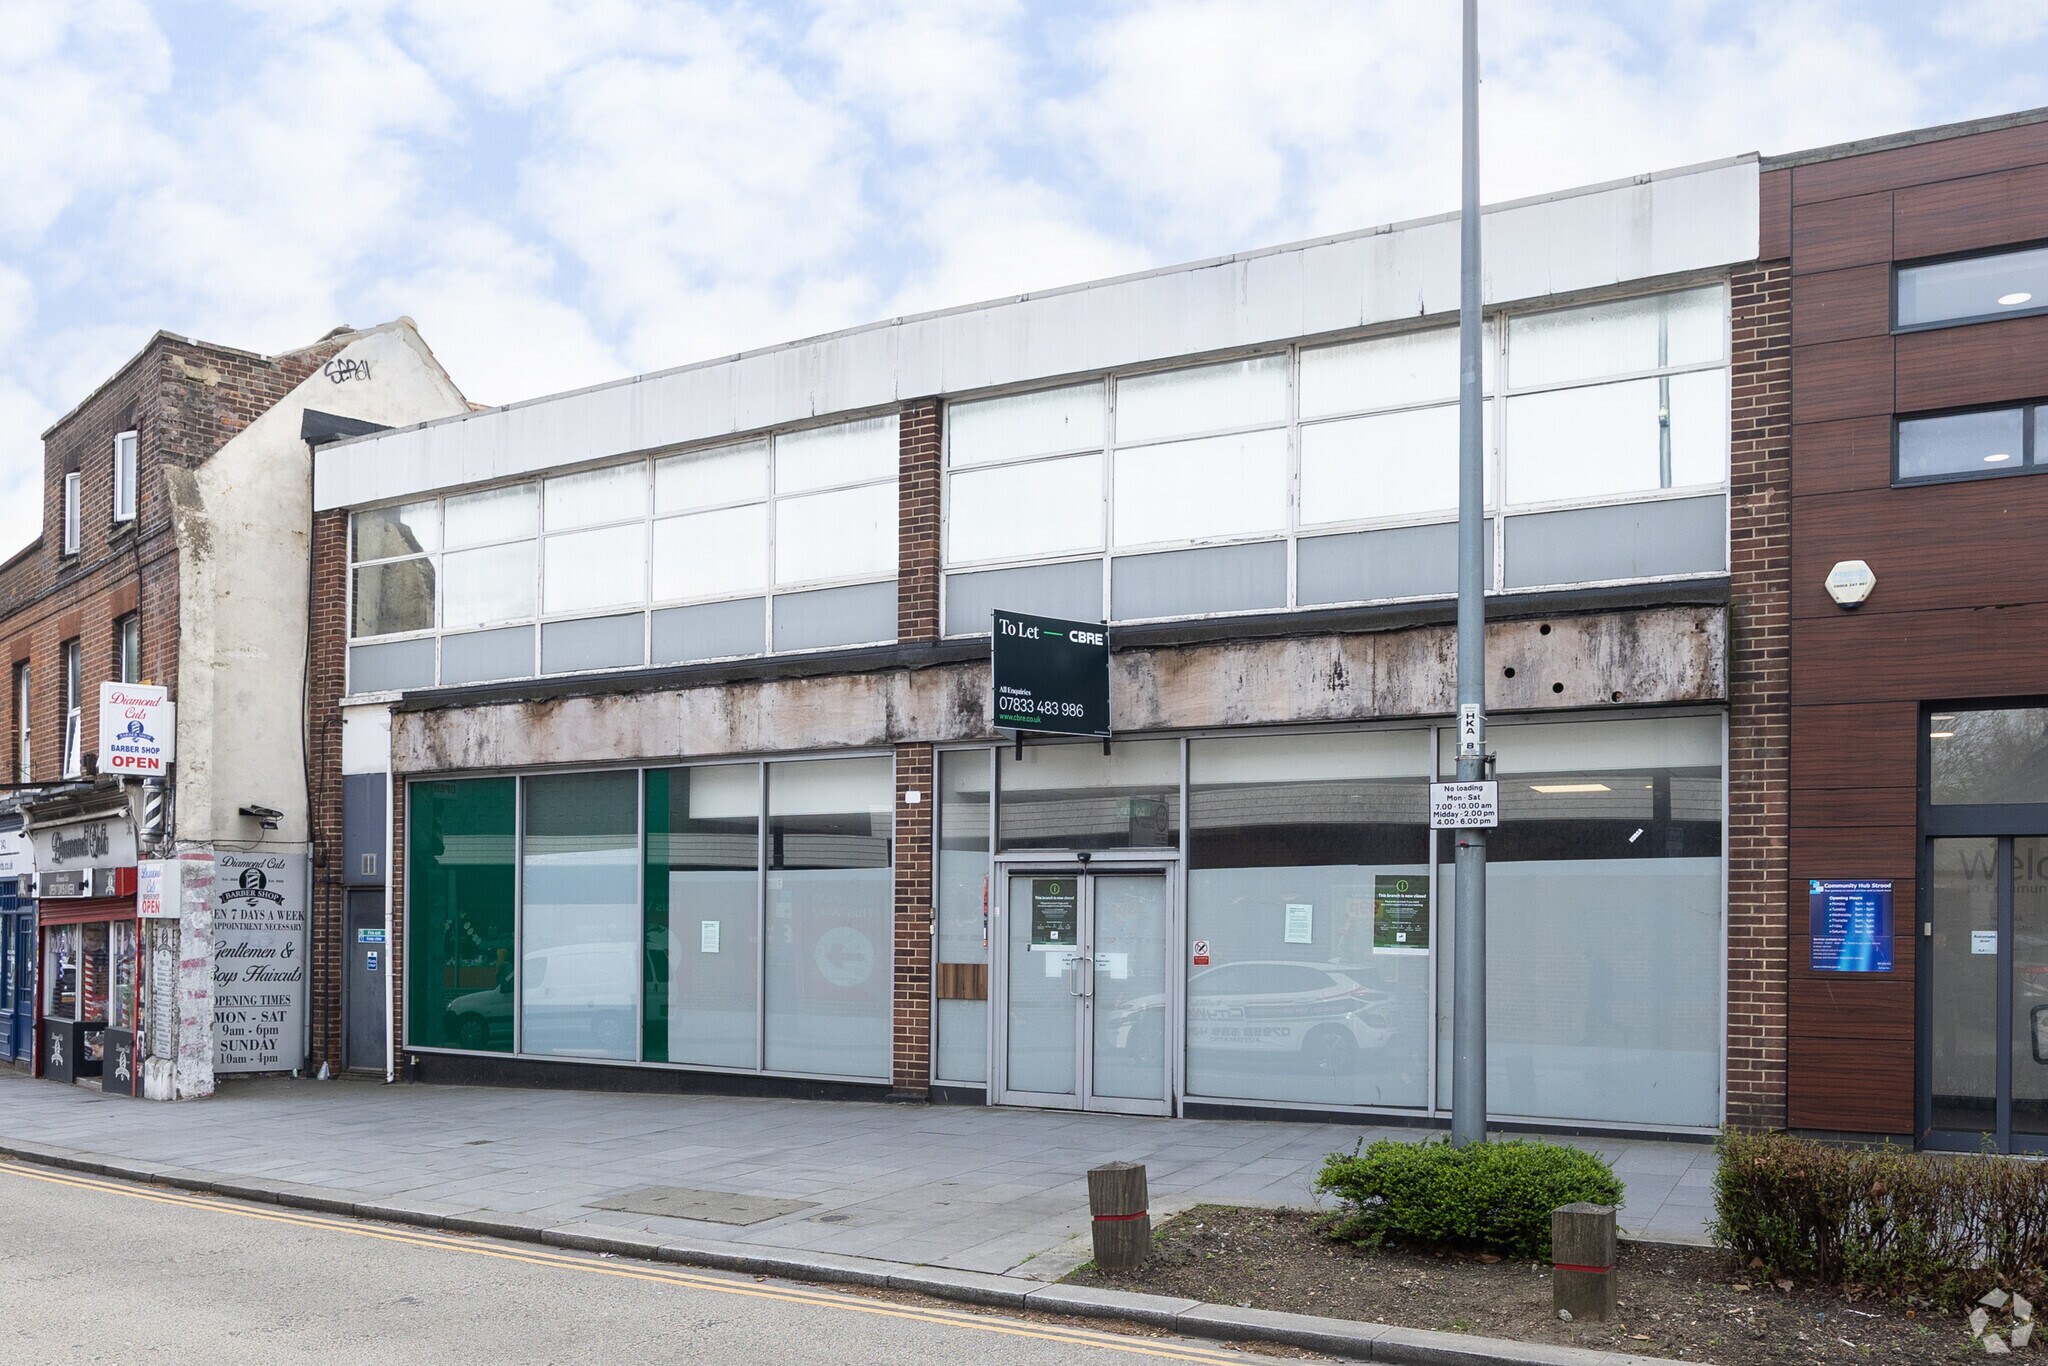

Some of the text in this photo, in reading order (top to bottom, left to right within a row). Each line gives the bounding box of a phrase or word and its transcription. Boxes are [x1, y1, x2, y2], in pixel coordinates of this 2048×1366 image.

[999, 619, 1039, 639] To Let
[1069, 630, 1103, 645] CBRE
[1008, 687, 1031, 696] Enquiries
[109, 691, 162, 707] Diamond
[124, 706, 146, 720] Cuts
[999, 696, 1084, 717] 07833 483 986
[999, 714, 1041, 723] www.cbre.co.uk
[111, 744, 160, 755] BARBER SHOP
[112, 756, 159, 769] OPEN
[220, 856, 285, 869] Diamond Cuts
[225, 889, 280, 900] BARBER SHOP
[142, 900, 160, 914] OPEN
[231, 909, 237, 920] 7
[241, 910, 265, 920] DAYS
[268, 910, 274, 920] A
[277, 910, 305, 920] WEEK
[265, 923, 303, 931] NECESSARY
[280, 942, 296, 958] &
[242, 964, 302, 982] Haircuts
[260, 994, 290, 1005] TIMES
[214, 1012, 247, 1024] MON
[261, 1011, 286, 1022] SAT
[222, 1024, 244, 1036] 9am
[256, 1024, 279, 1038] 6pm
[220, 1039, 277, 1052] SUNDAY
[220, 1054, 247, 1064] 10am
[257, 1053, 278, 1065] 4pm
